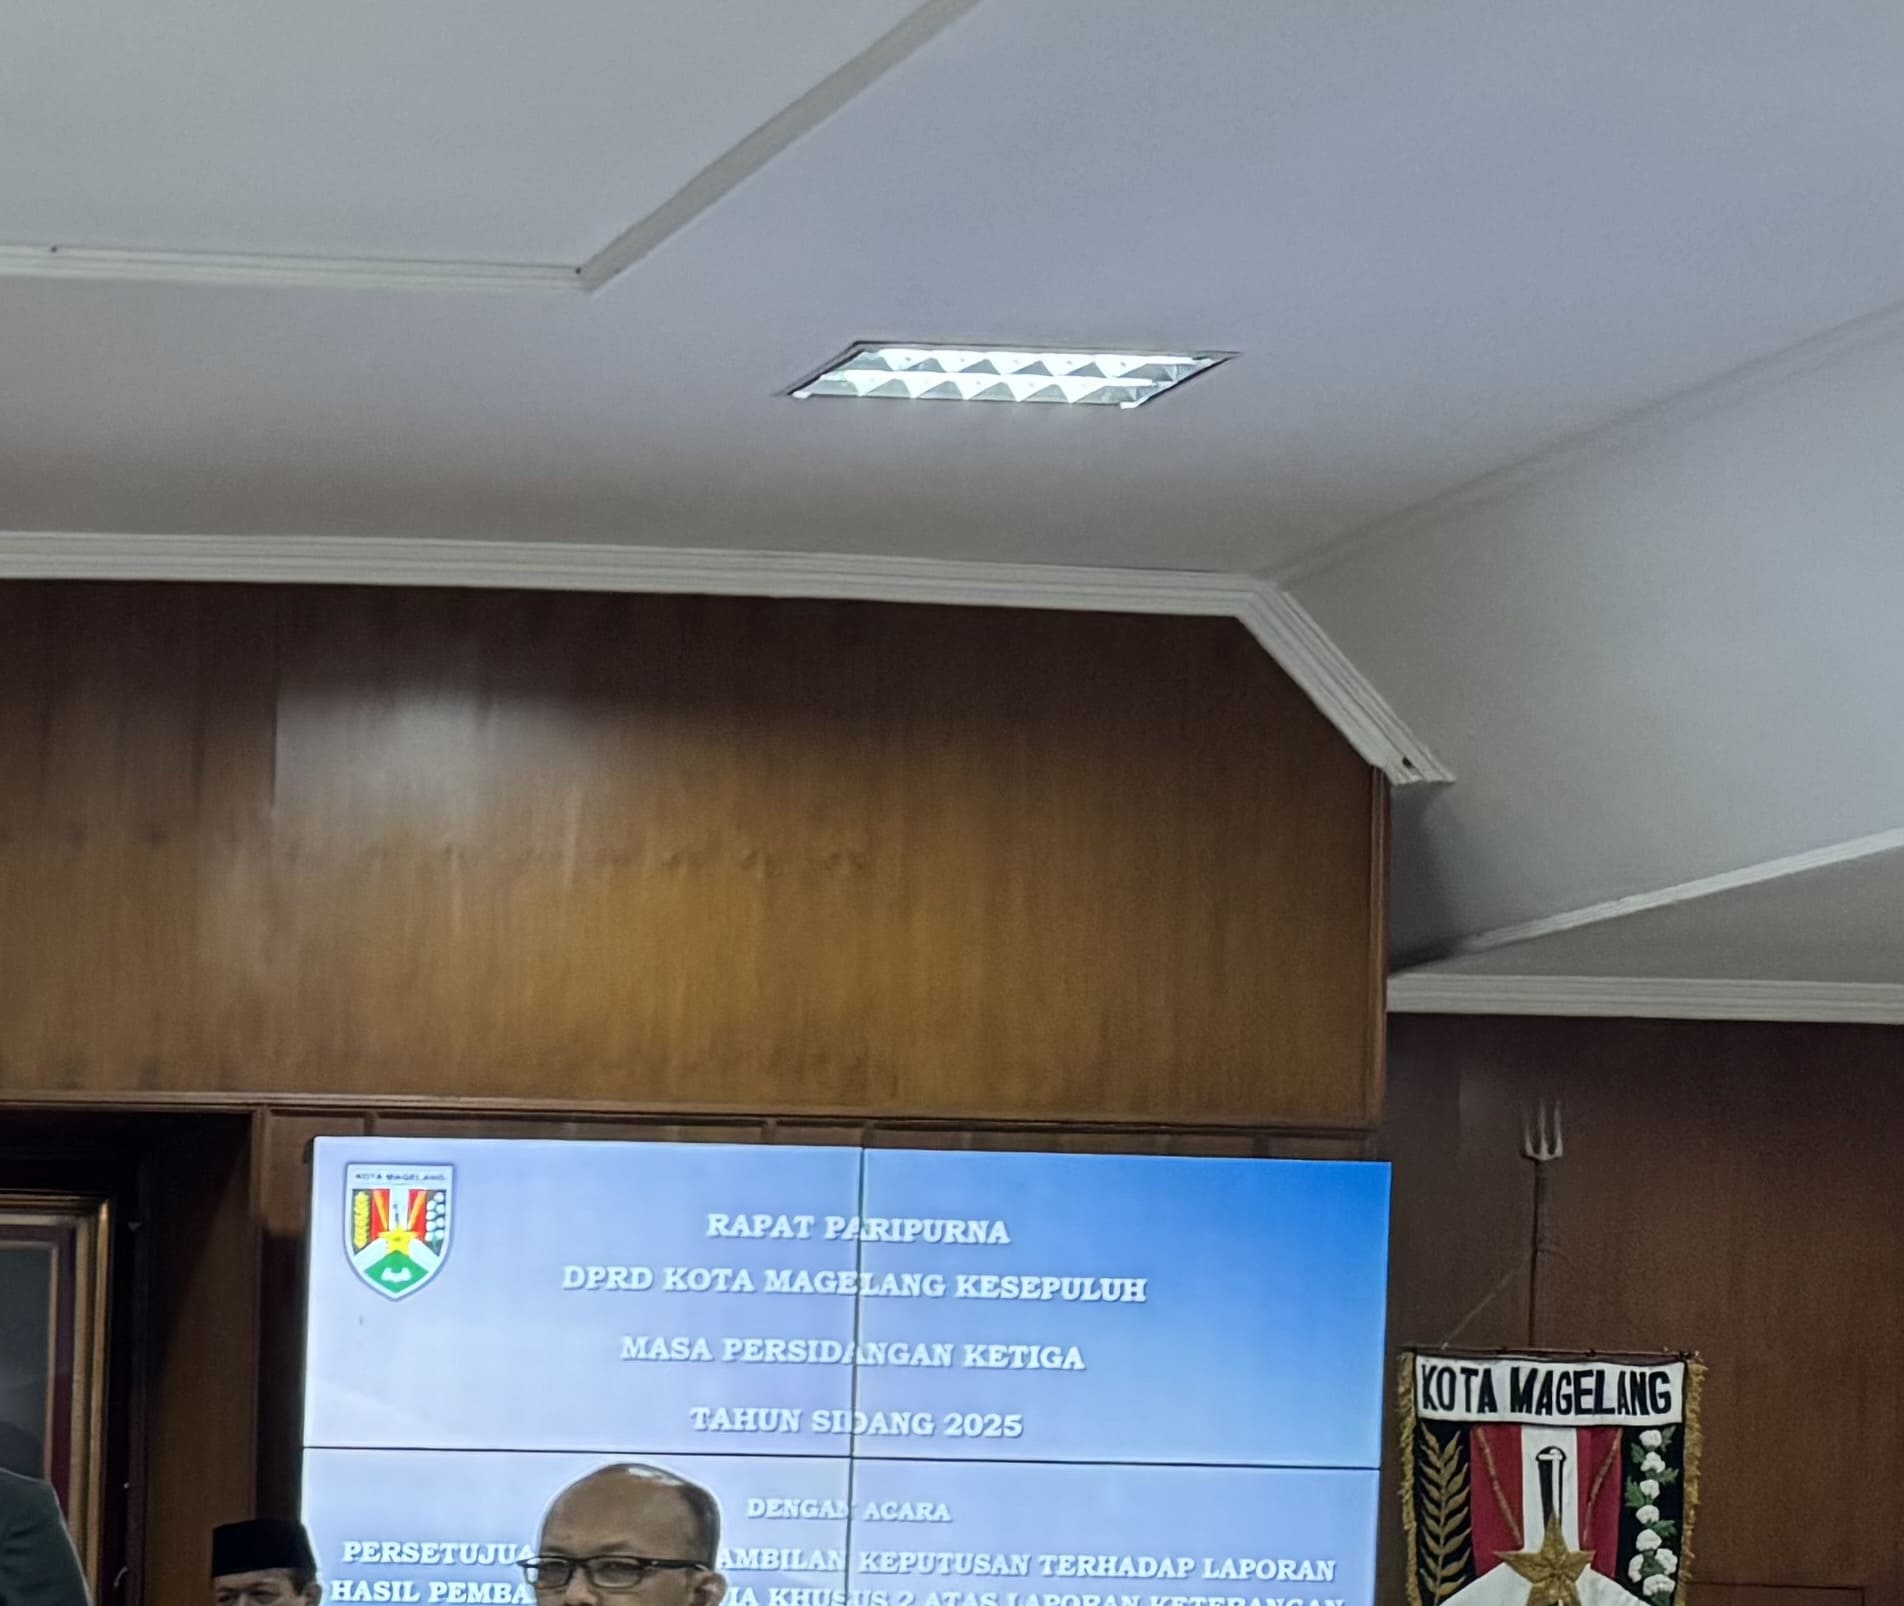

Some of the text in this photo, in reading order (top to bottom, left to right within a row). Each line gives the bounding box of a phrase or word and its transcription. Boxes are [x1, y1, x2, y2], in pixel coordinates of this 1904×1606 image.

[707, 1213, 1011, 1245] RAPAT PARIPURNA
[562, 1265, 1147, 1303] DPRD KOTA MAGELANG KESEPULUH
[620, 1336, 1086, 1371] MASA PERSIDANGAN KETIGA
[1420, 1364, 1672, 1416] KOTA MAGELANG
[690, 1407, 1023, 1439] TAHUN SIDANG 2025
[864, 1501, 952, 1523] ACARA
[343, 1541, 1336, 1583] PERSETUJUA AMBILAN KEPUTUSAN TERHADAP LAPORAN
[331, 1580, 420, 1603] HASIL
